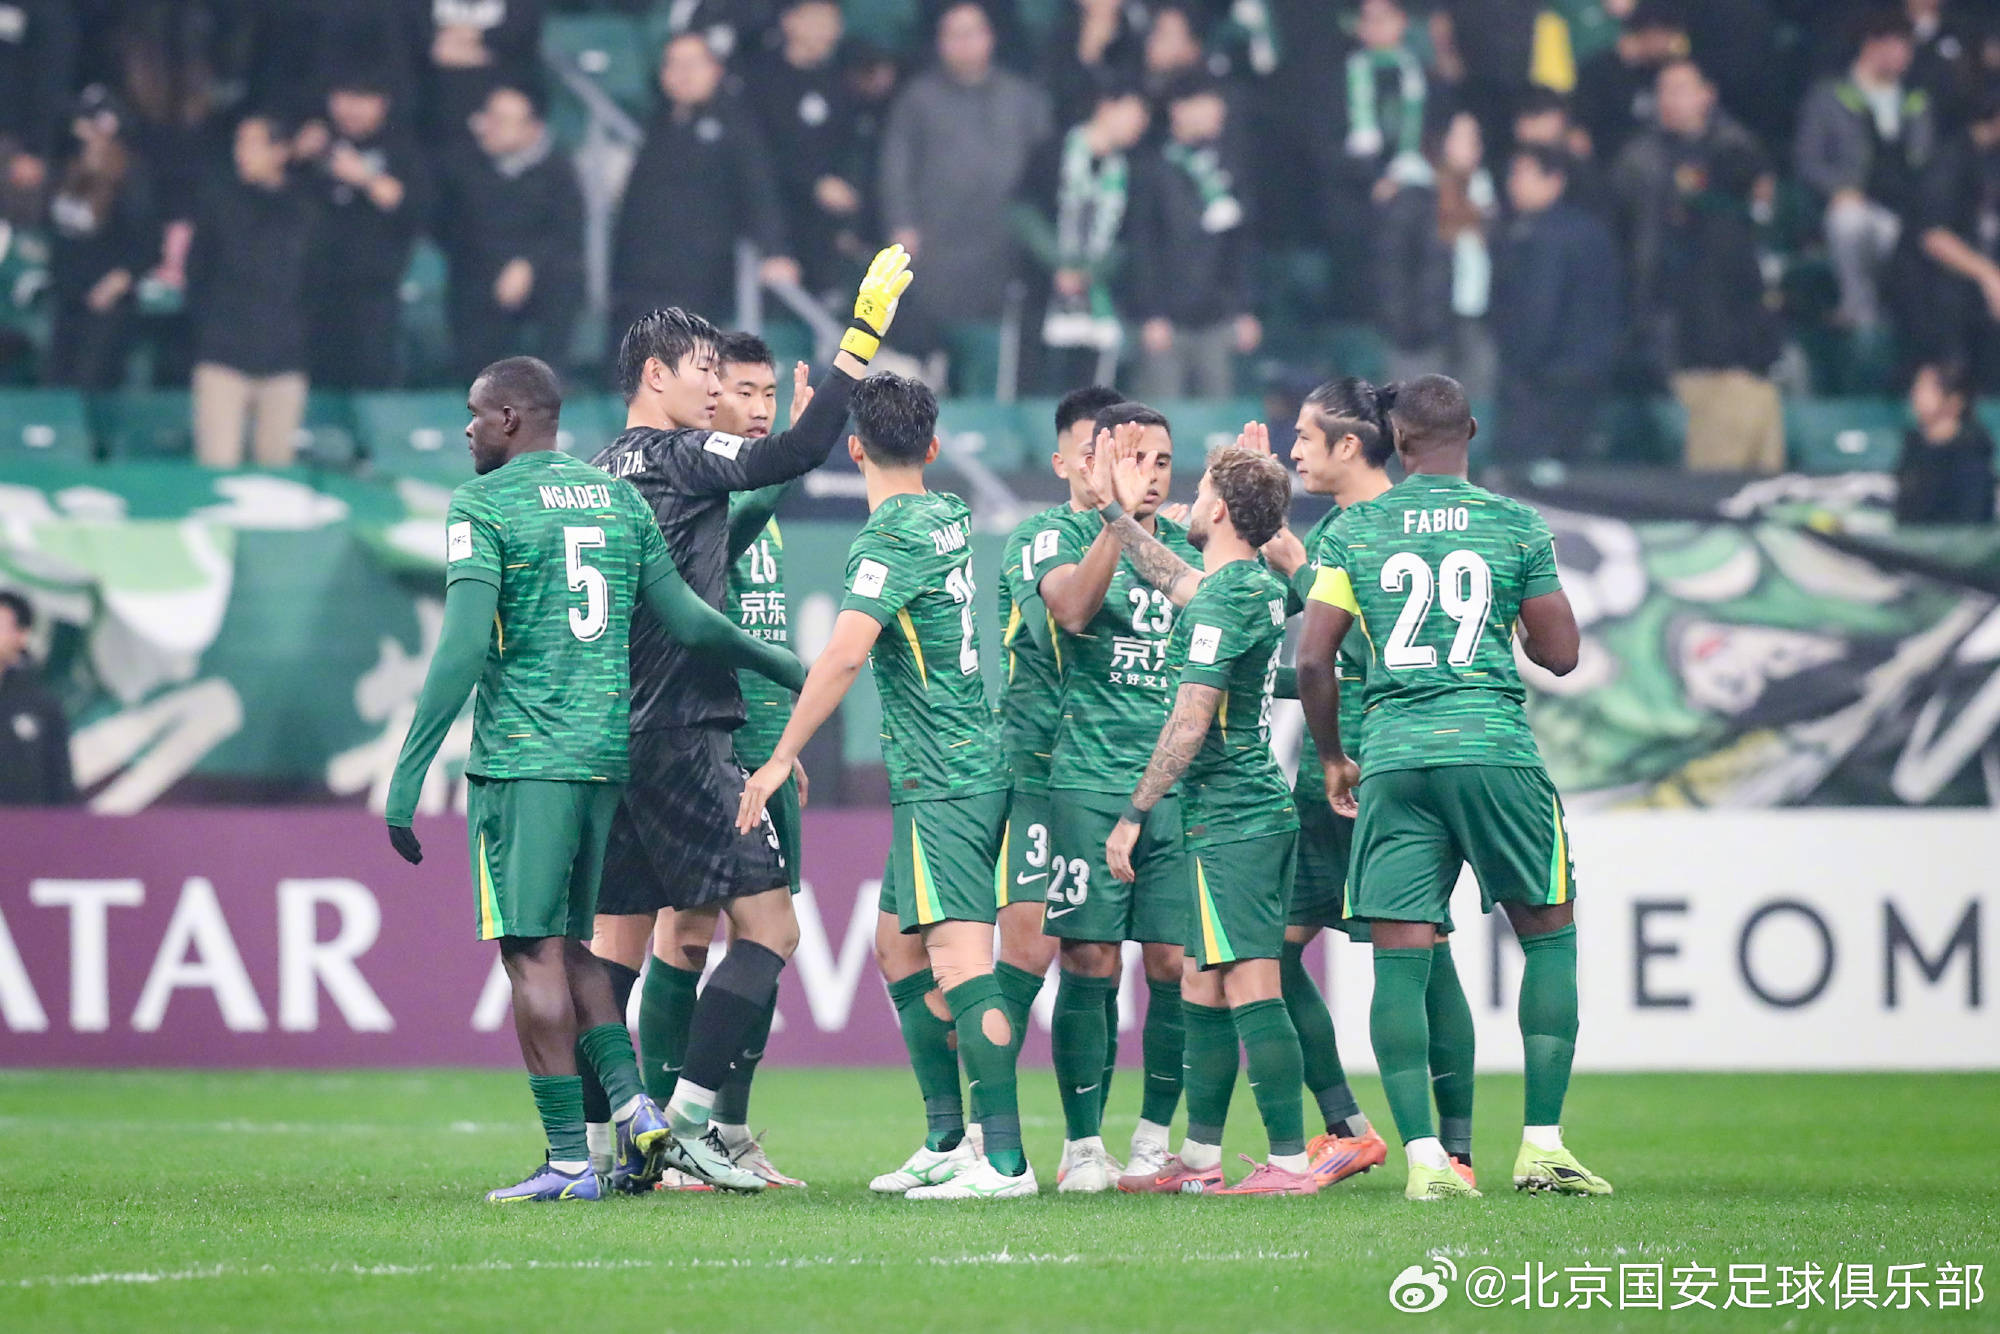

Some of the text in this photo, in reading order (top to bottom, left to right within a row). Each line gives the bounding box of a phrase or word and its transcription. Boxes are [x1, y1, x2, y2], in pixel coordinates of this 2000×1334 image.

[538, 484, 612, 509] NGADEU
[928, 521, 966, 555] ZHANG
[1403, 507, 1469, 534] FABIO
[563, 526, 609, 642] 5
[744, 539, 777, 584] 26
[740, 591, 787, 625] 京东
[1128, 587, 1174, 634] 23
[1380, 549, 1492, 670] 29
[1025, 823, 1048, 868] 3
[1046, 855, 1090, 905] 23
